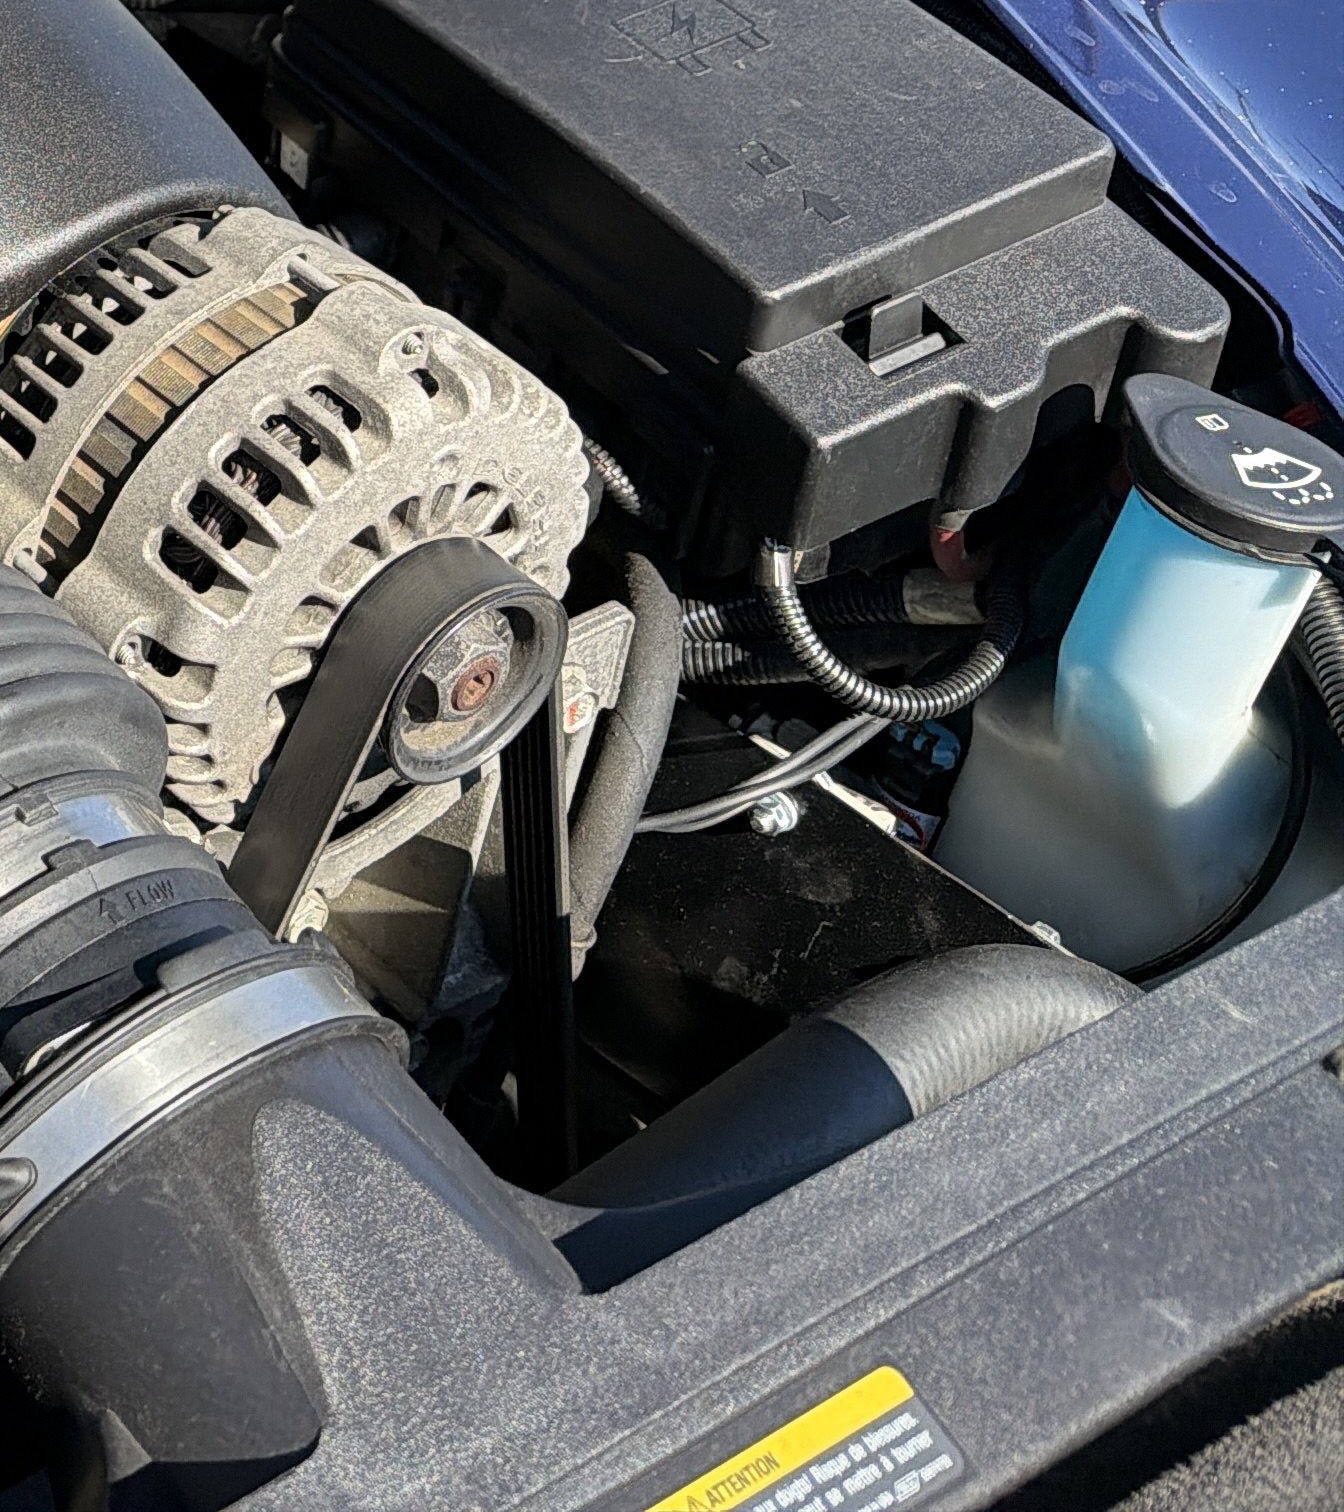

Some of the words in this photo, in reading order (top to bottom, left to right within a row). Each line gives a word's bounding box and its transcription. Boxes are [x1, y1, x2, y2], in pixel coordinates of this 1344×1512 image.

[125, 880, 174, 911] FLOW
[706, 1452, 780, 1509] ATTENTION
[809, 1453, 852, 1487] Risque
[851, 1443, 868, 1462] de
[825, 1488, 845, 1506] se
[842, 1464, 882, 1494] mettre
[879, 1454, 896, 1472] à
[890, 1430, 933, 1464] tourner
